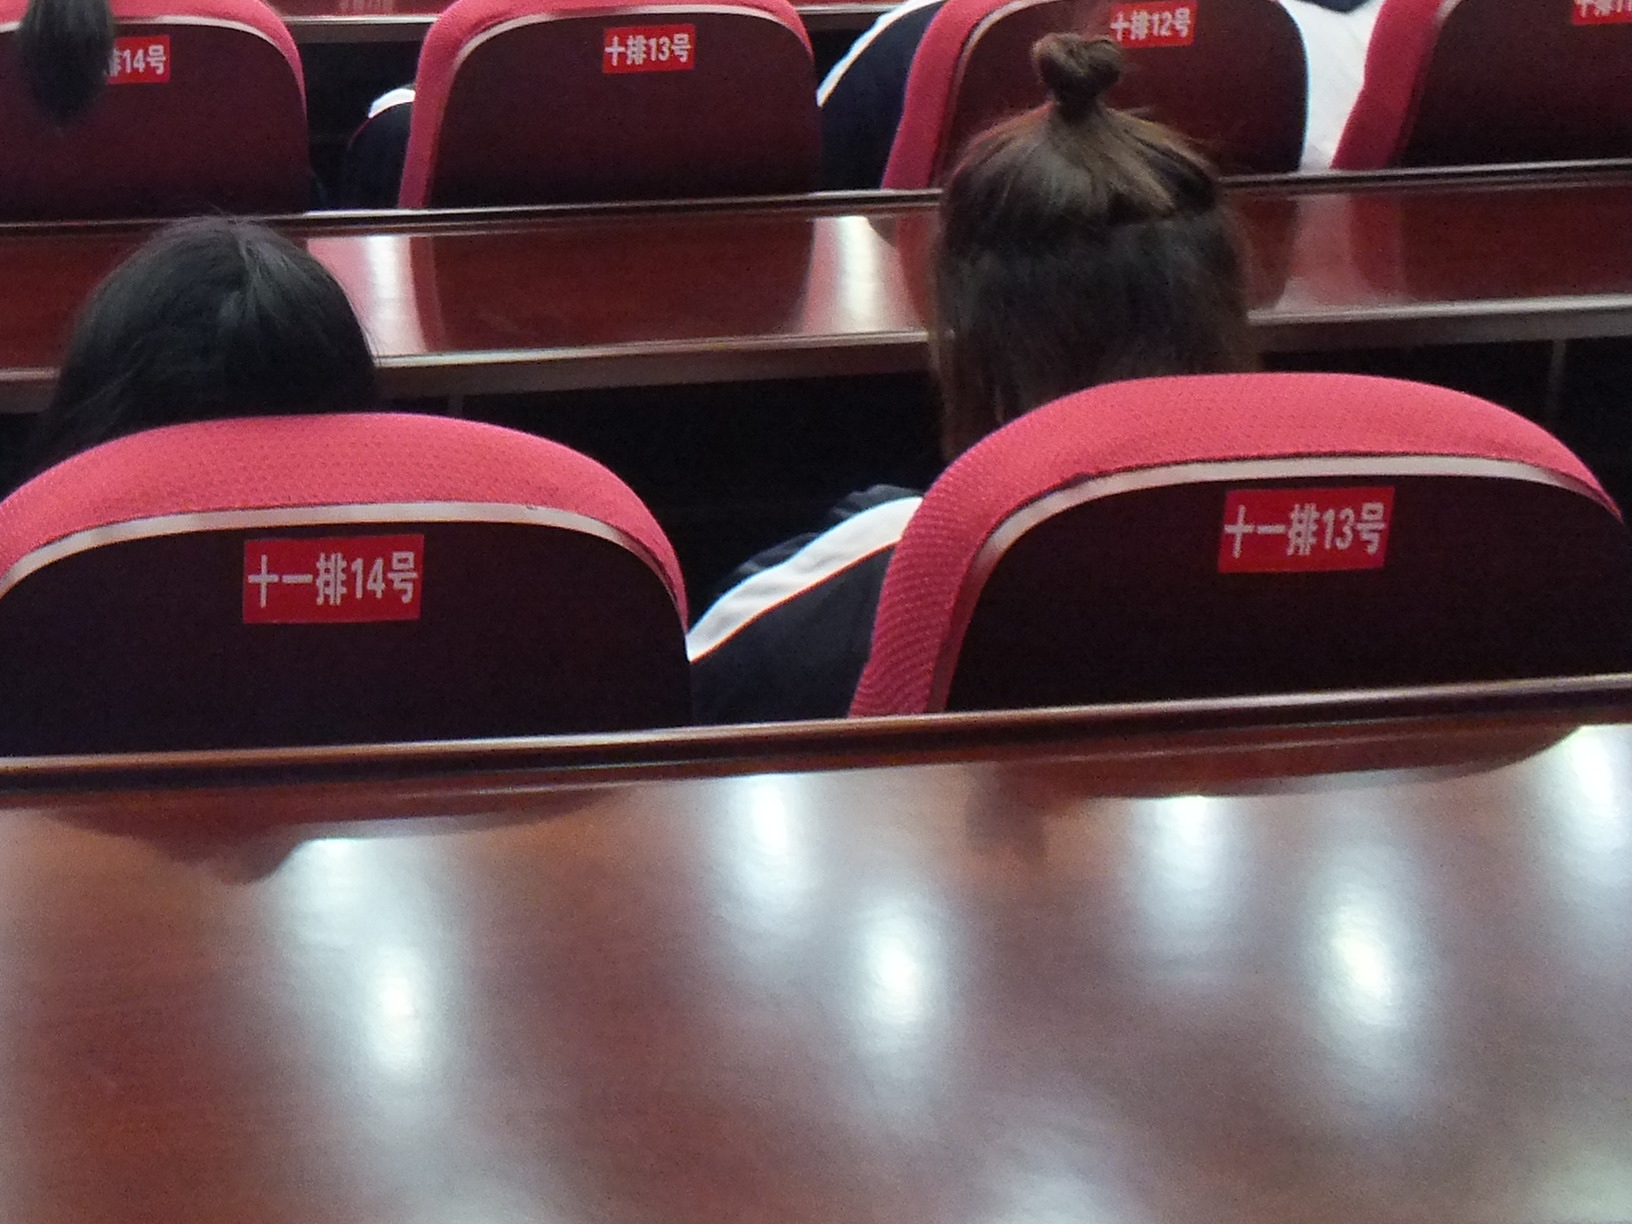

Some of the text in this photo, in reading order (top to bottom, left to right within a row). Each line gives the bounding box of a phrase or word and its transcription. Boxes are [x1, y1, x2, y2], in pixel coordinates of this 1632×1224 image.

[1109, 7, 1191, 44] 十排12号
[604, 32, 692, 68] 十排13号
[1223, 501, 1386, 562] 十一排13号
[247, 550, 419, 610] 十一排14号
